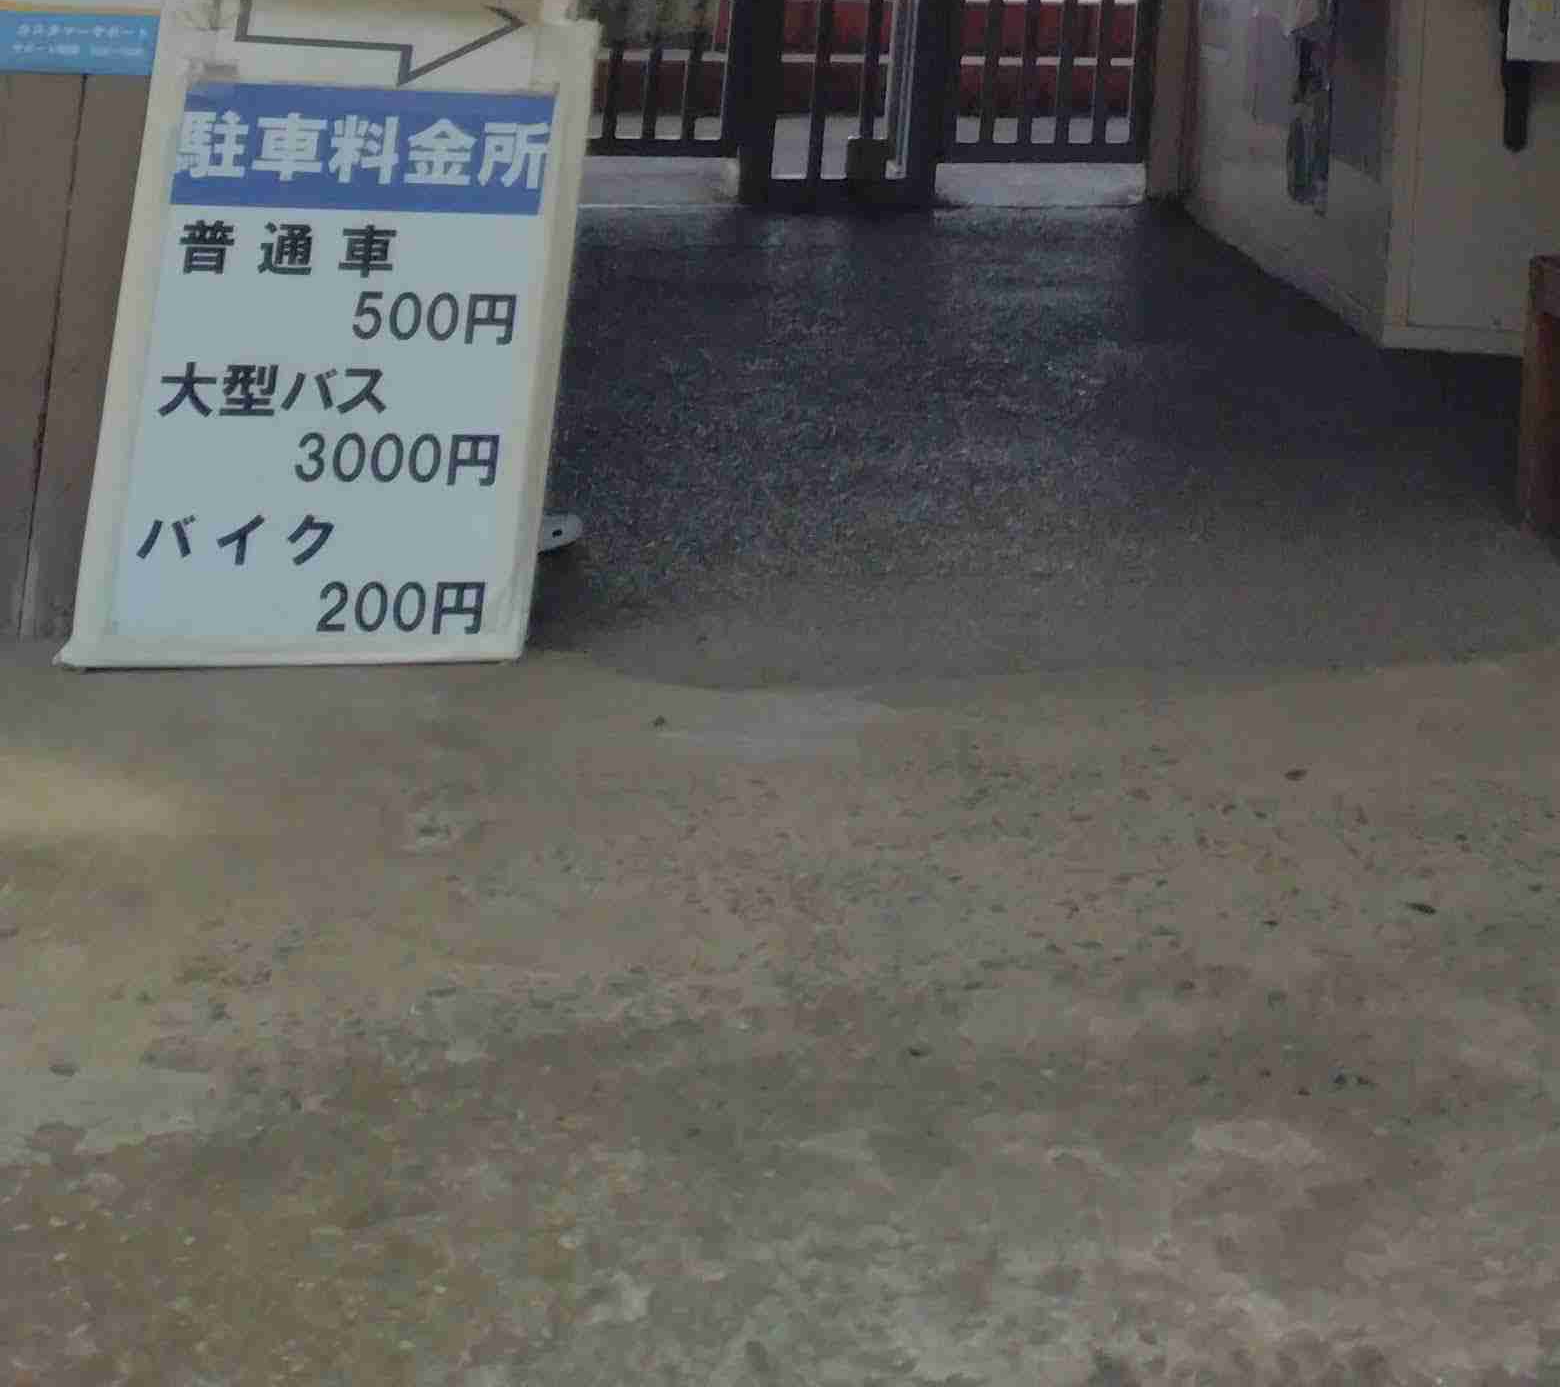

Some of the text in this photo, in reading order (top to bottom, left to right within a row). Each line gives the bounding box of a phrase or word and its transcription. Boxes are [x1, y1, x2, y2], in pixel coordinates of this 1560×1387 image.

[175, 109, 552, 191] 駐車料金所
[178, 220, 397, 278] 普通車
[352, 290, 518, 348] 500円
[158, 361, 388, 418] 大型バス
[294, 432, 501, 488] 3000円
[136, 513, 336, 567] バイク
[316, 580, 487, 636] 200円
